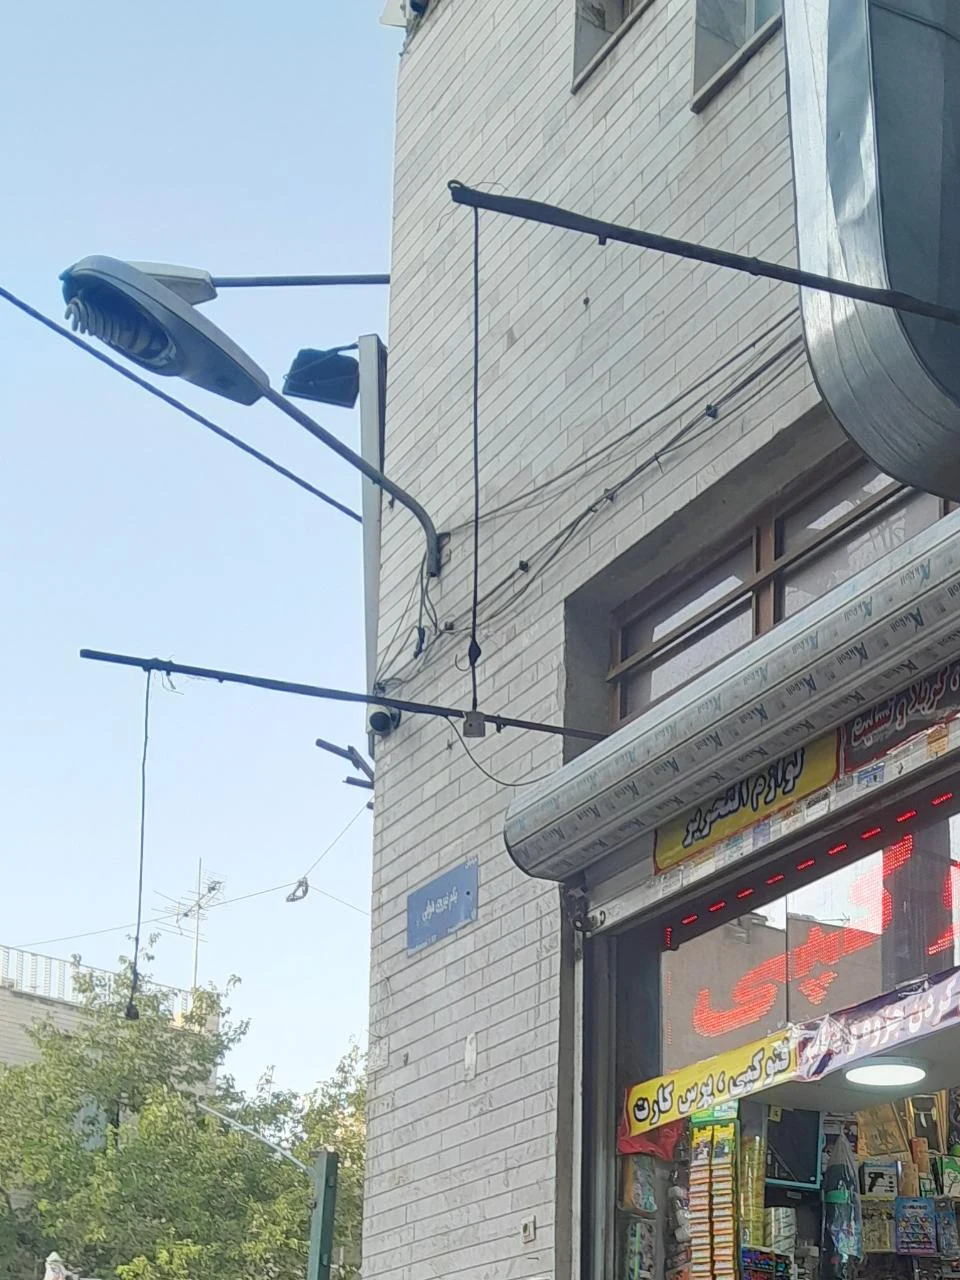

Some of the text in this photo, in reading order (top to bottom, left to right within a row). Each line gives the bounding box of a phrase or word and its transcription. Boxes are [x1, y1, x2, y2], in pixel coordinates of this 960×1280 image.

[896, 695, 908, 730] و
[908, 664, 950, 715] کربلا
[751, 746, 806, 812] لوازم
[632, 1080, 674, 1125] کارت
